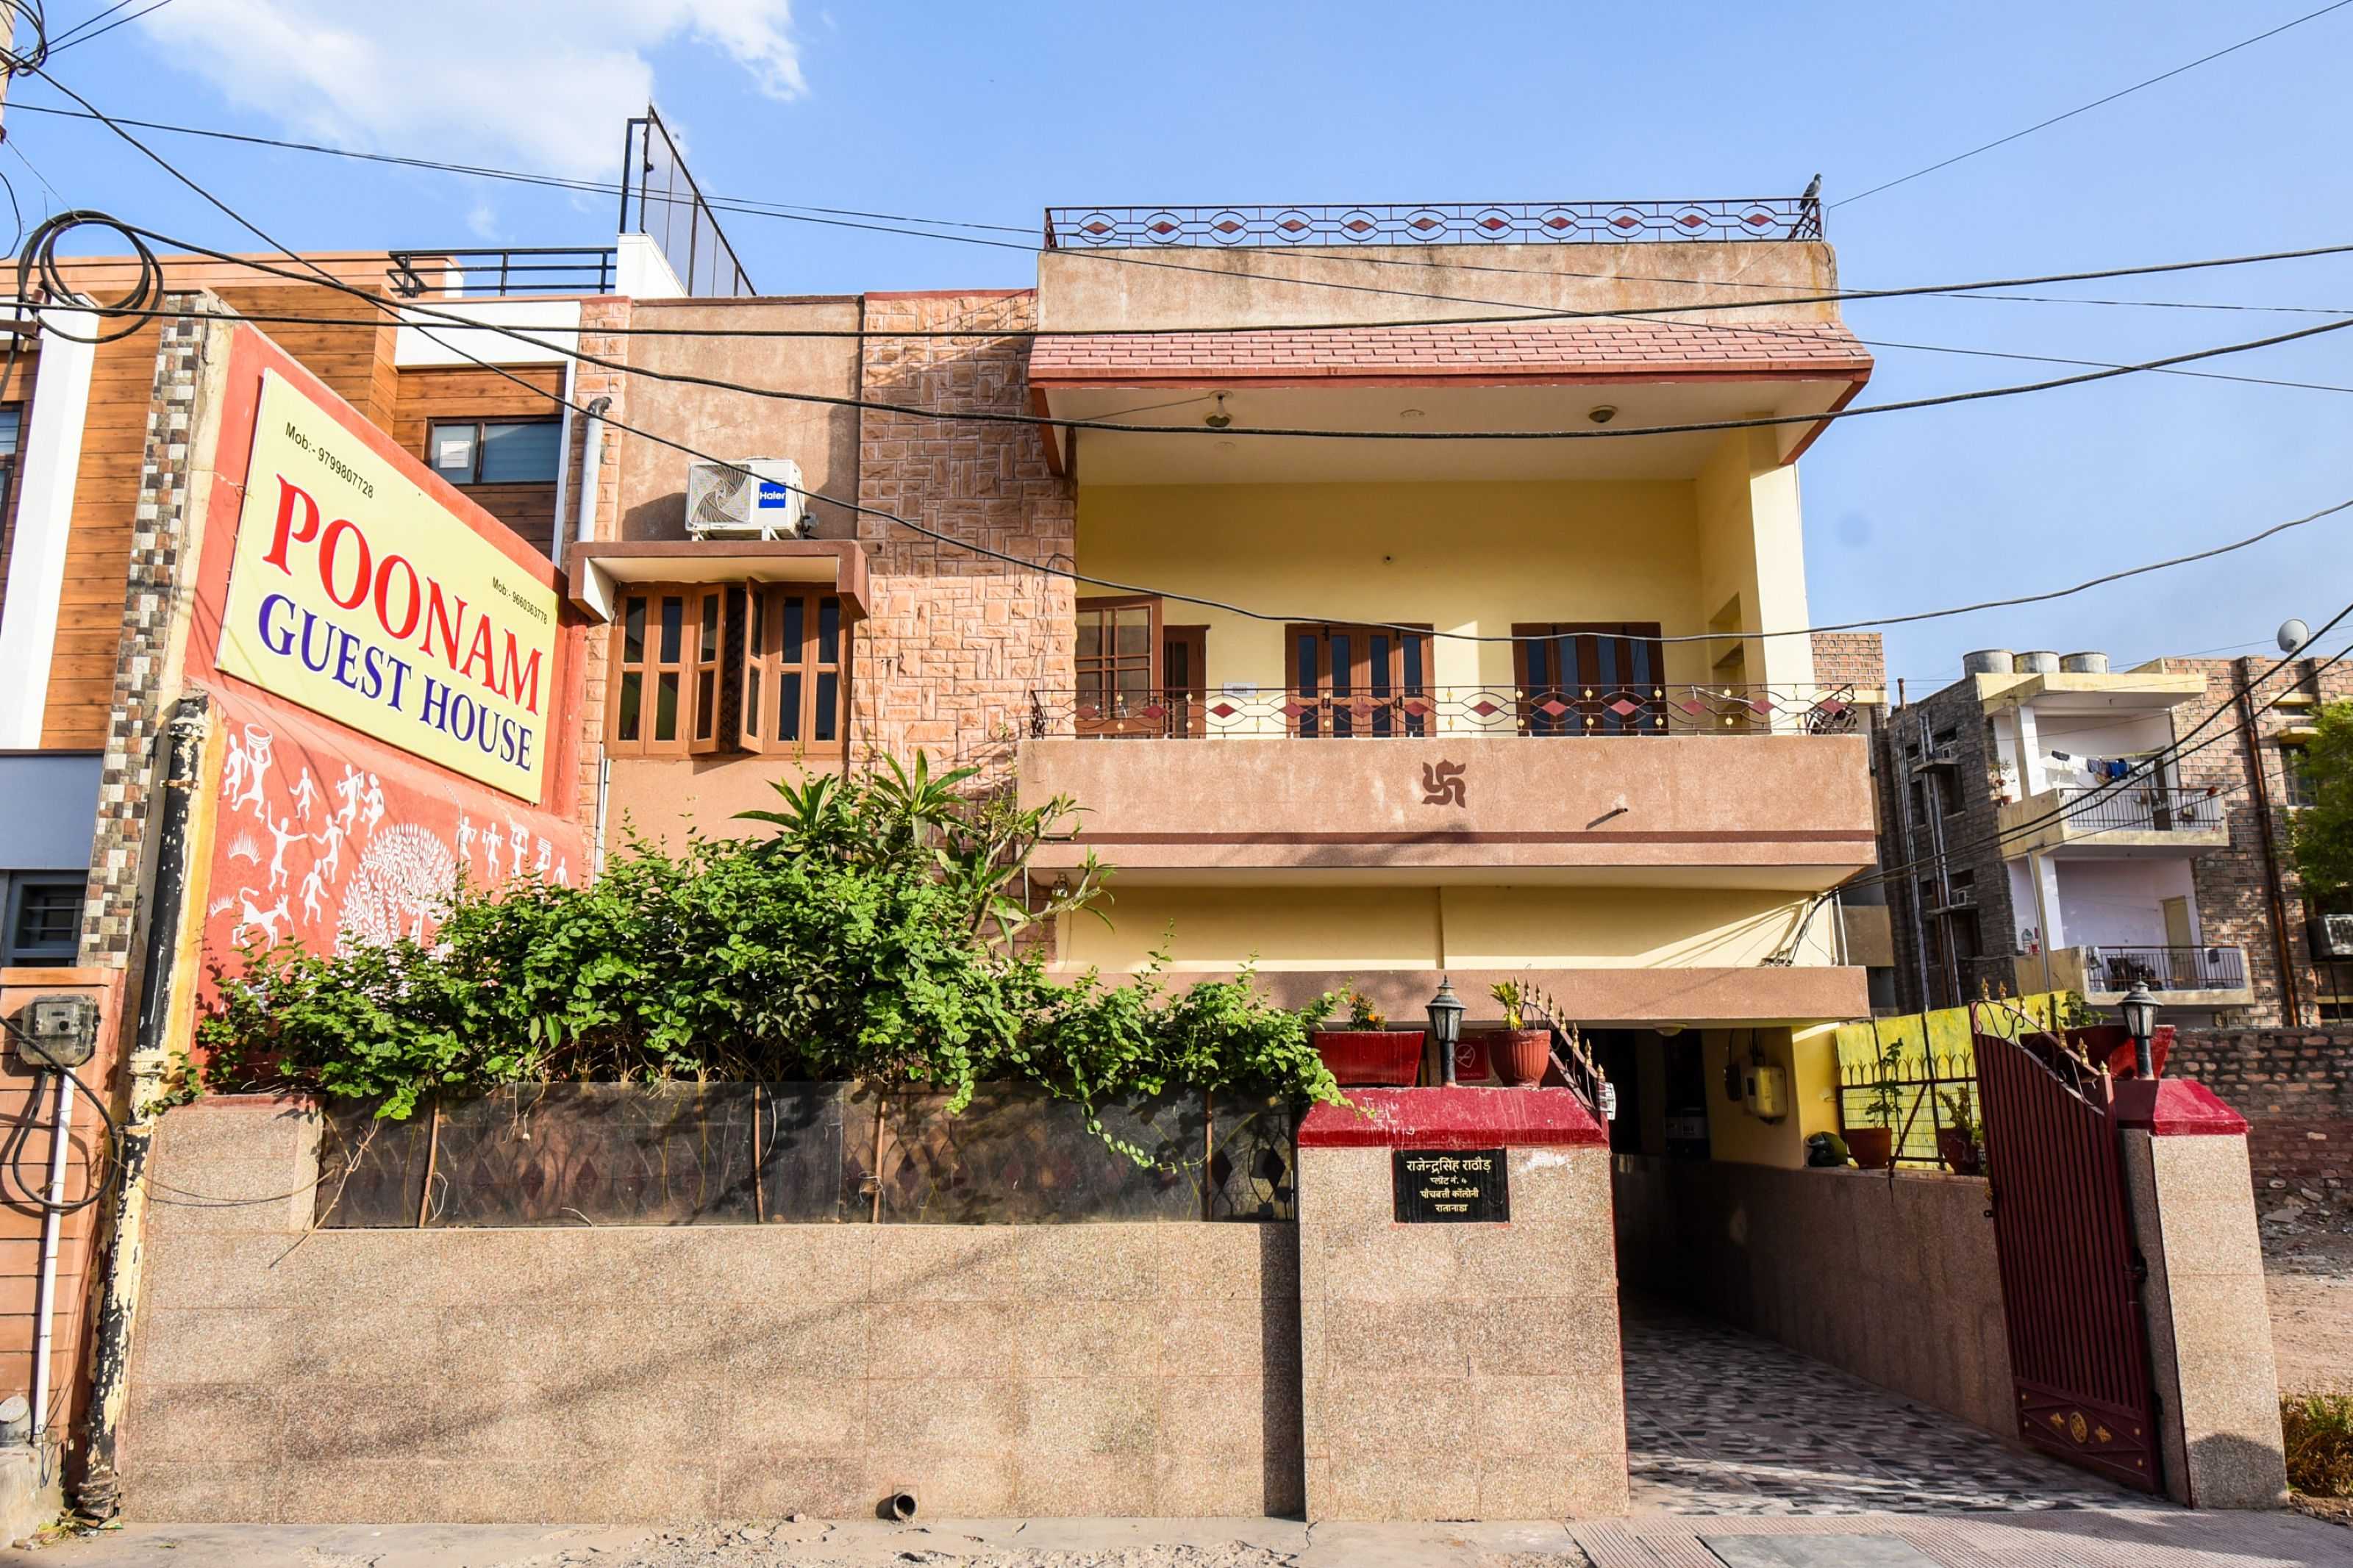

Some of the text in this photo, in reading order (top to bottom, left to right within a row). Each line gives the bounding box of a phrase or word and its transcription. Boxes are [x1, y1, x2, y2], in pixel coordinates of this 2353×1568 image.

[318, 447, 374, 499] 9799807728
[759, 491, 786, 500] Haier
[262, 473, 543, 717] POONAM
[512, 591, 548, 625] 9660363778
[257, 593, 533, 772] GUEST HOUSE
[1406, 1156, 1492, 1174] राजेन्द्रसिंह राठौड़
